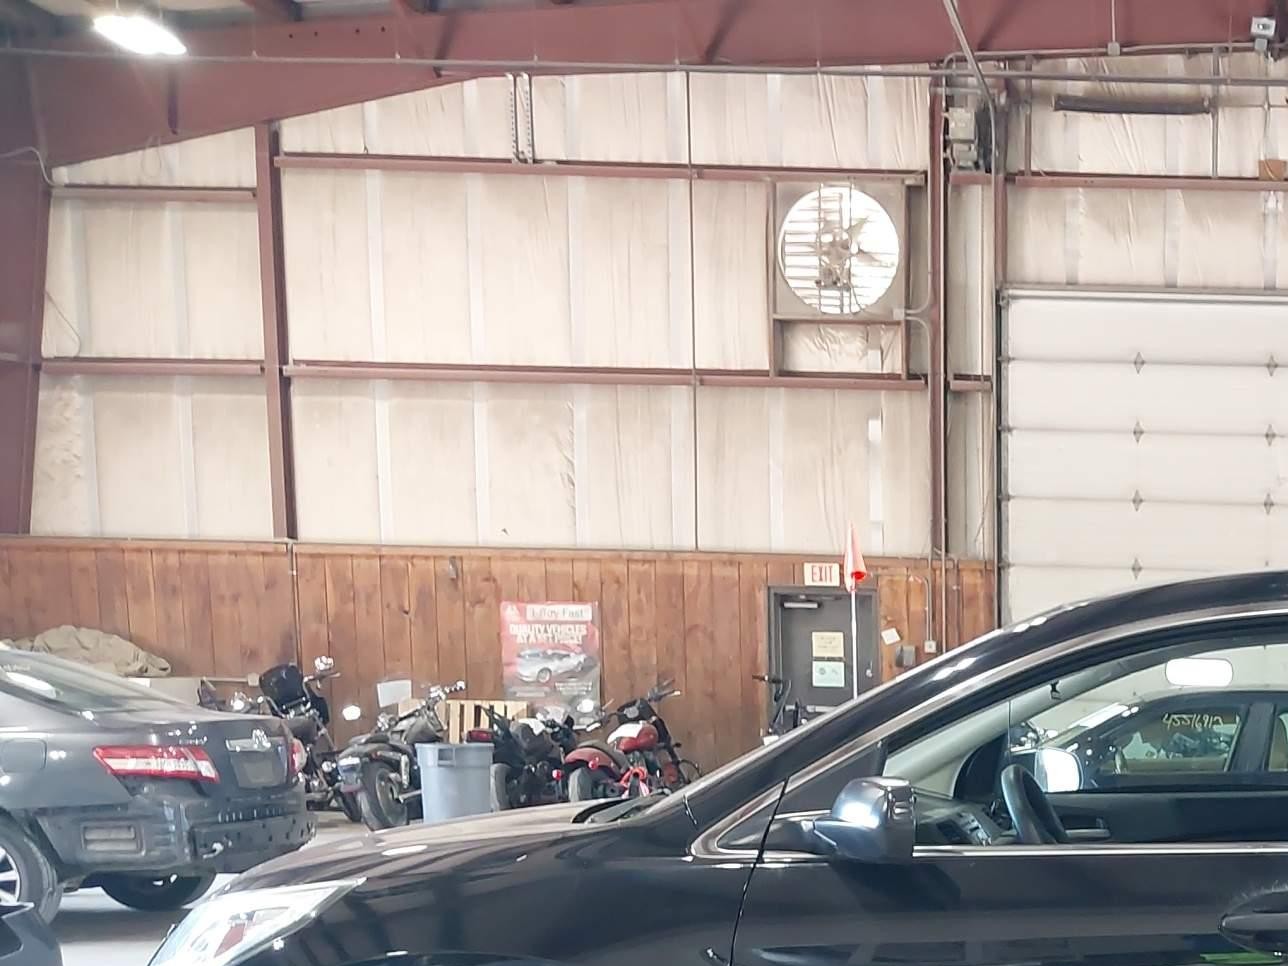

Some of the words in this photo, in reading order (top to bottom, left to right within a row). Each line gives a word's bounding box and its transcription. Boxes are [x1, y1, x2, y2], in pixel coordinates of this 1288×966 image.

[811, 564, 833, 583] EXIT
[509, 623, 545, 635] QUALITY
[545, 624, 587, 635] VEHICLES
